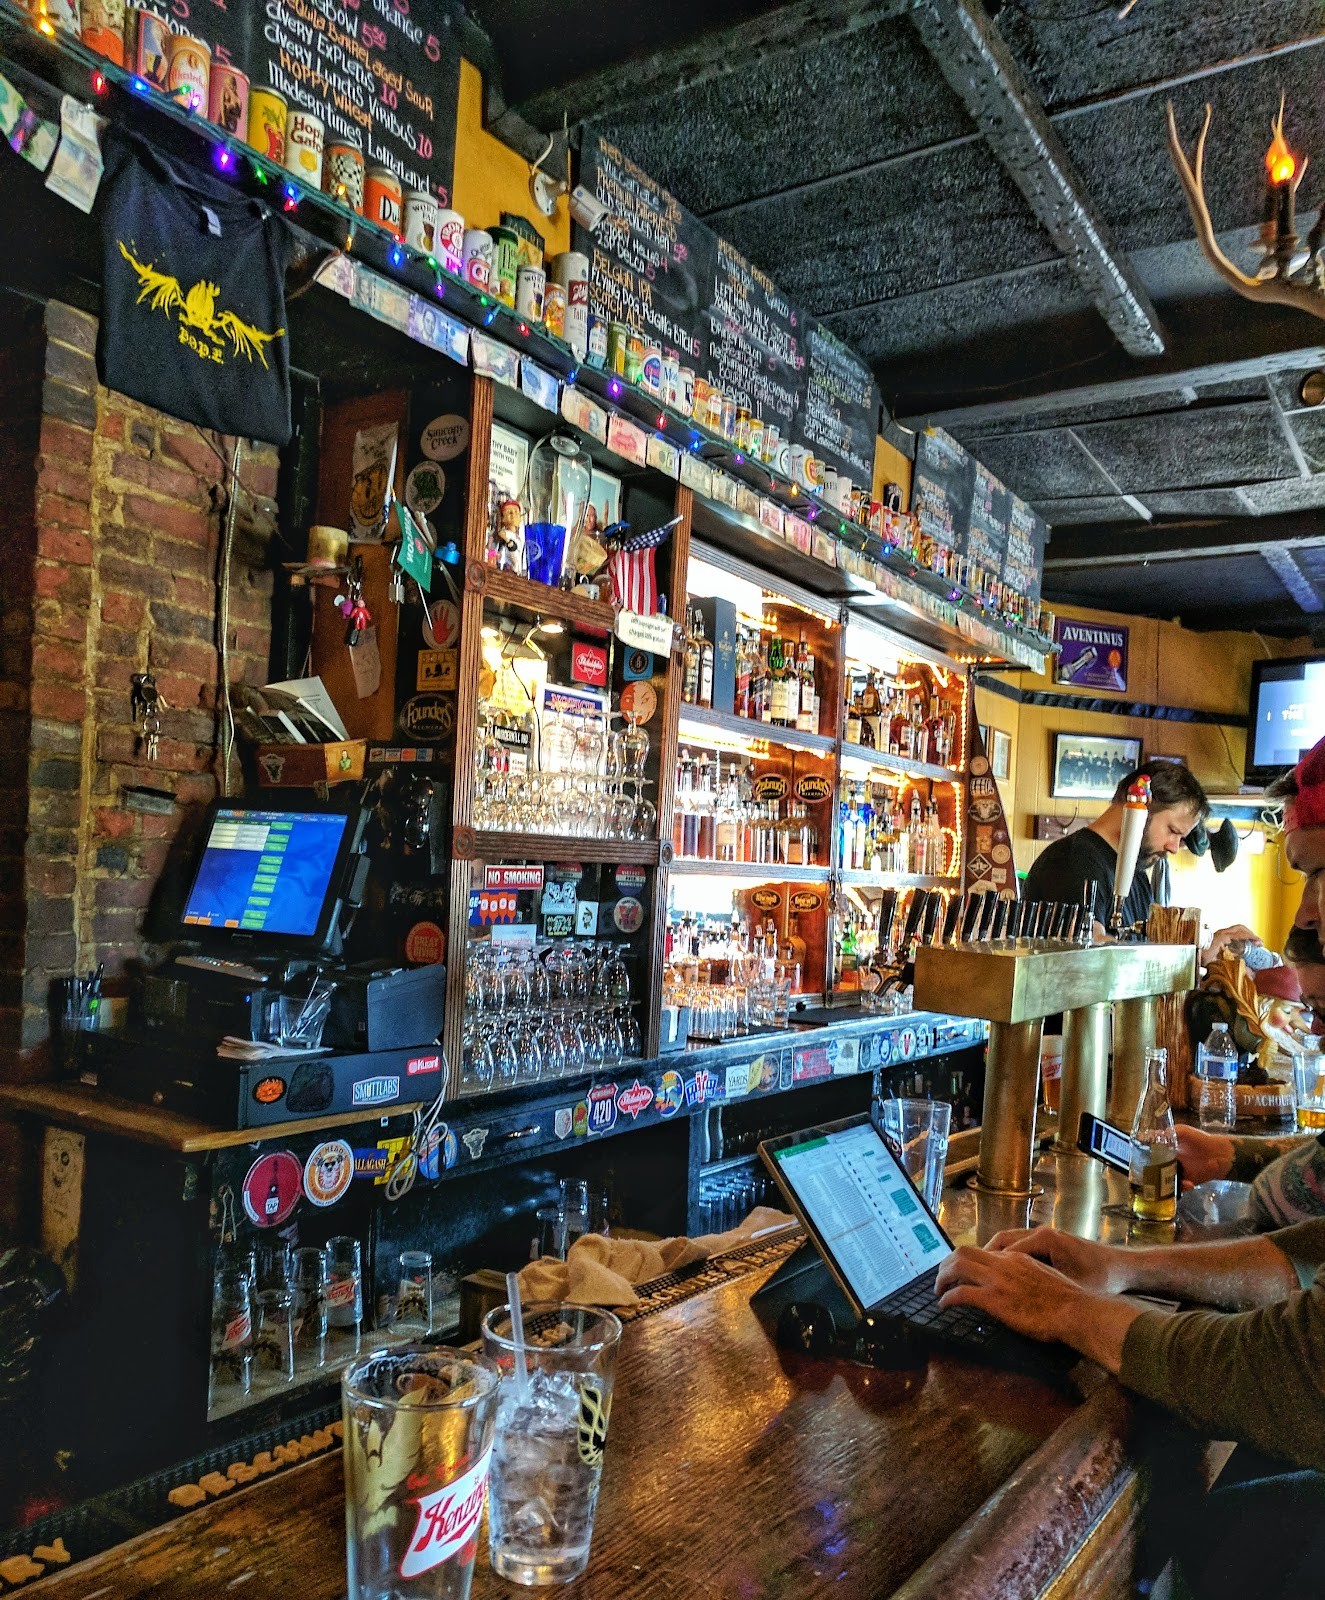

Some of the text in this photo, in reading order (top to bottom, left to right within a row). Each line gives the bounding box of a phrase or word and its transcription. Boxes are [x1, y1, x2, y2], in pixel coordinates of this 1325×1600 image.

[417, 132, 433, 159] 10
[589, 281, 622, 319] SCOTCH
[626, 309, 645, 334] ALE
[693, 338, 700, 357] 5
[1062, 626, 1124, 647] AVENTINUS
[487, 871, 541, 885] NO SMOKING
[354, 1079, 398, 1100] SMUTTLABS
[593, 1099, 612, 1125] 420
